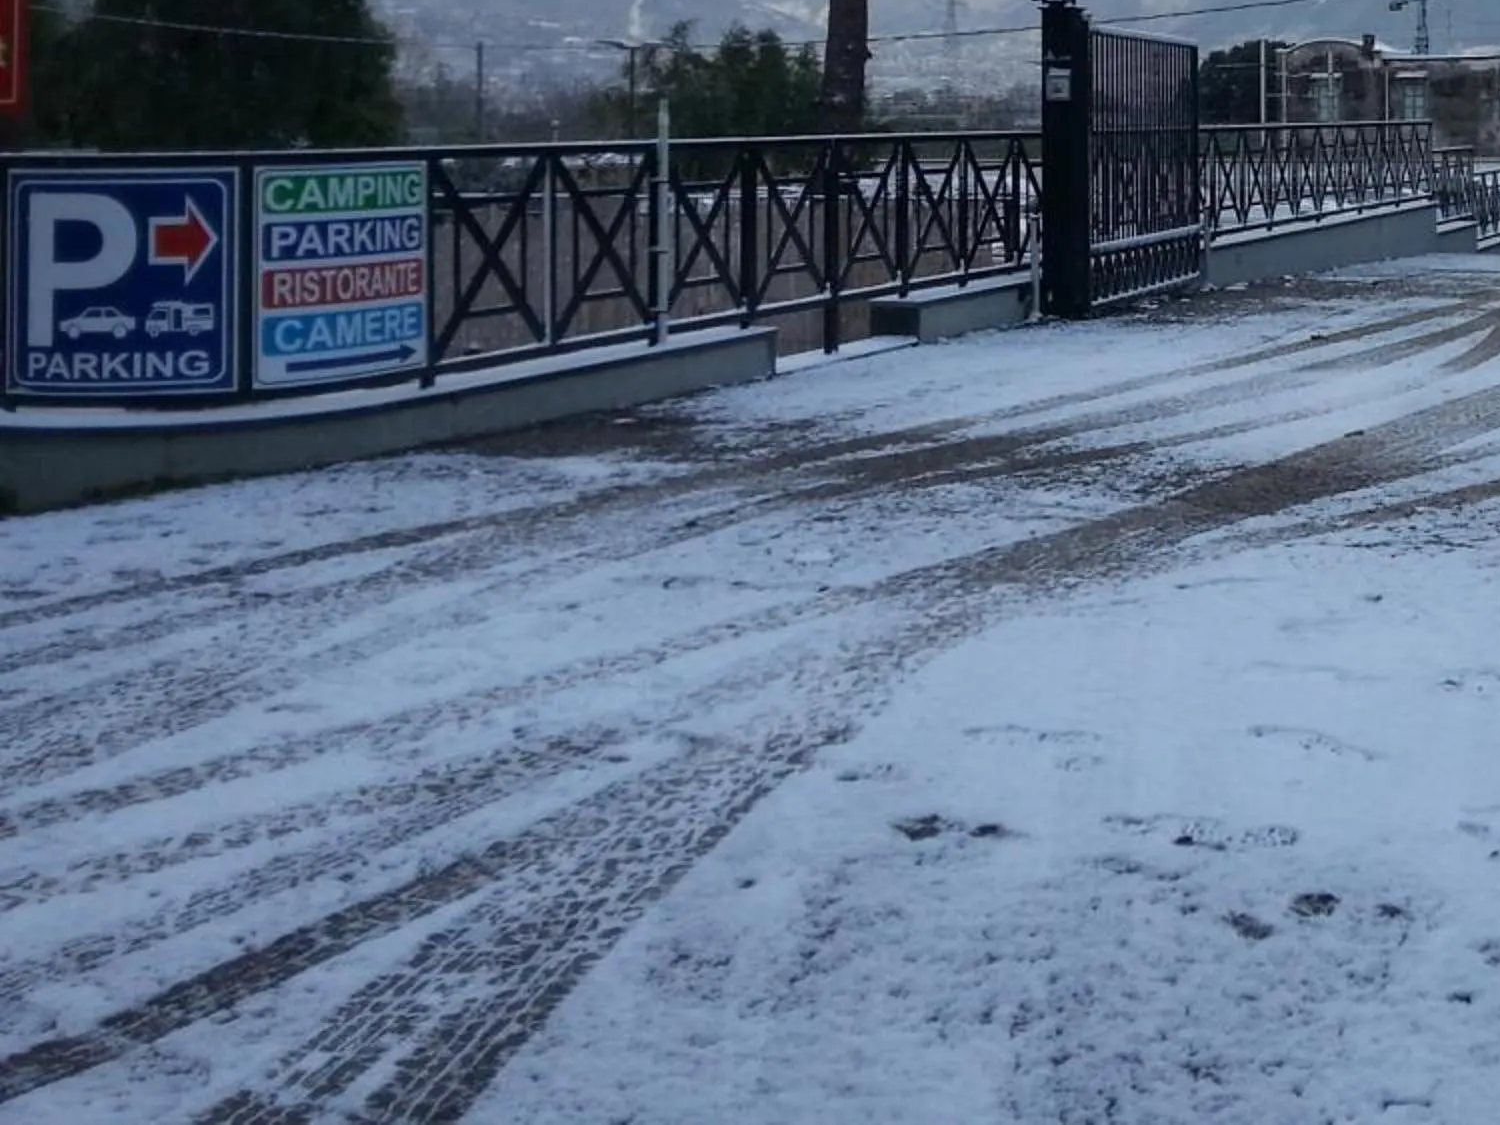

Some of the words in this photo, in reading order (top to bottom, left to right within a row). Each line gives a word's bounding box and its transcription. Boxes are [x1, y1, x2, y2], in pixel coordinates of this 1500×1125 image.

[265, 175, 423, 211] CAMPING
[270, 218, 421, 258] PARKING
[28, 192, 138, 348] P
[273, 262, 420, 306] RISTORANTE
[273, 313, 419, 352] CAMERE
[28, 350, 211, 380] PARKING
